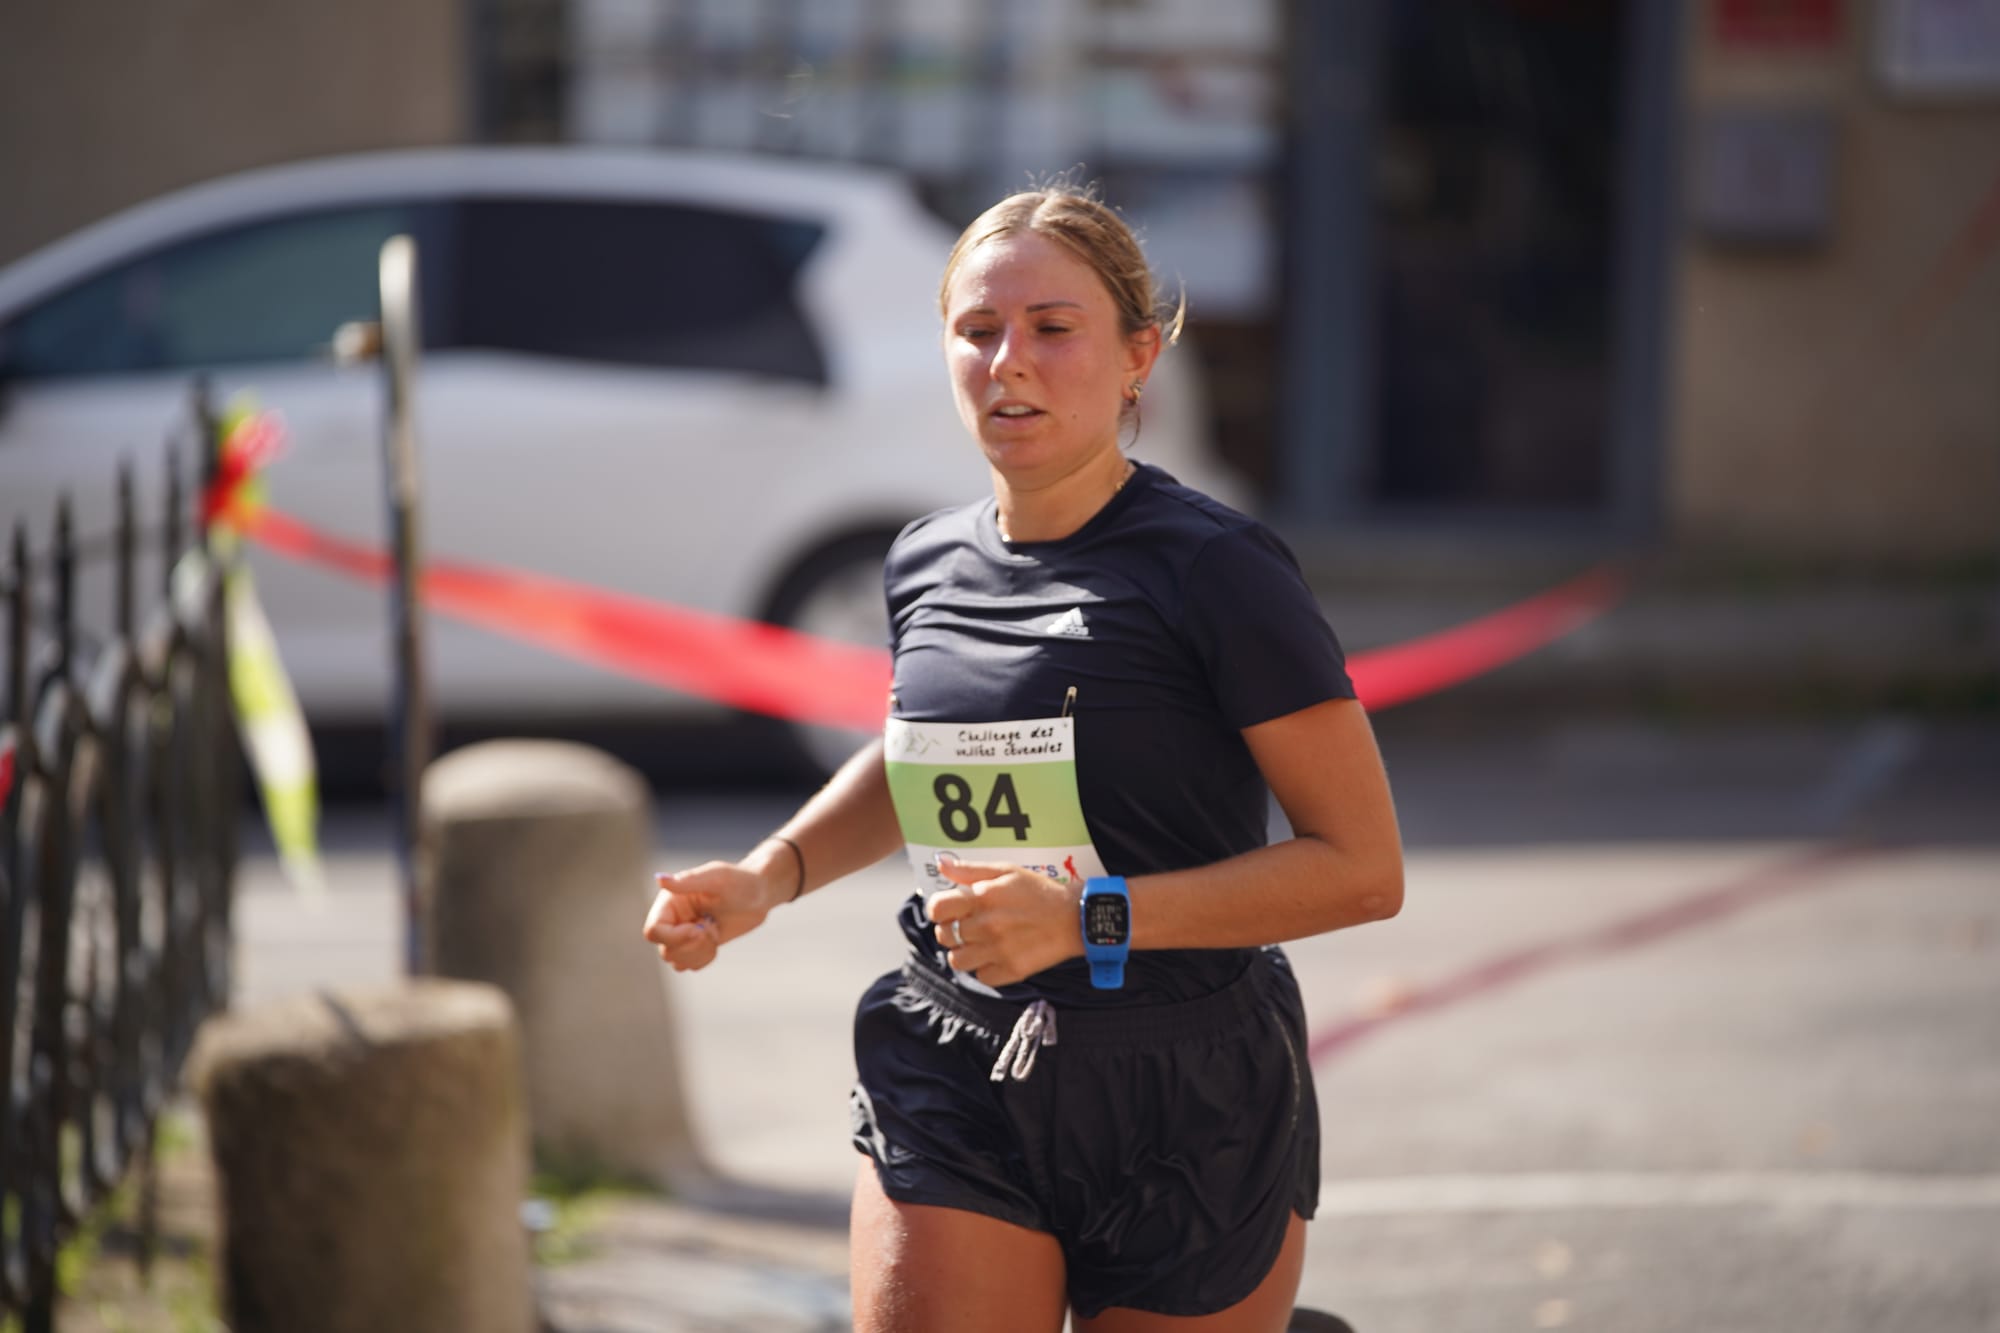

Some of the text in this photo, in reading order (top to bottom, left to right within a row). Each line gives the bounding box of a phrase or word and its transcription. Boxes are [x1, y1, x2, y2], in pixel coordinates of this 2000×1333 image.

[958, 726, 1054, 746] Challenge des
[933, 773, 1032, 843] 84
